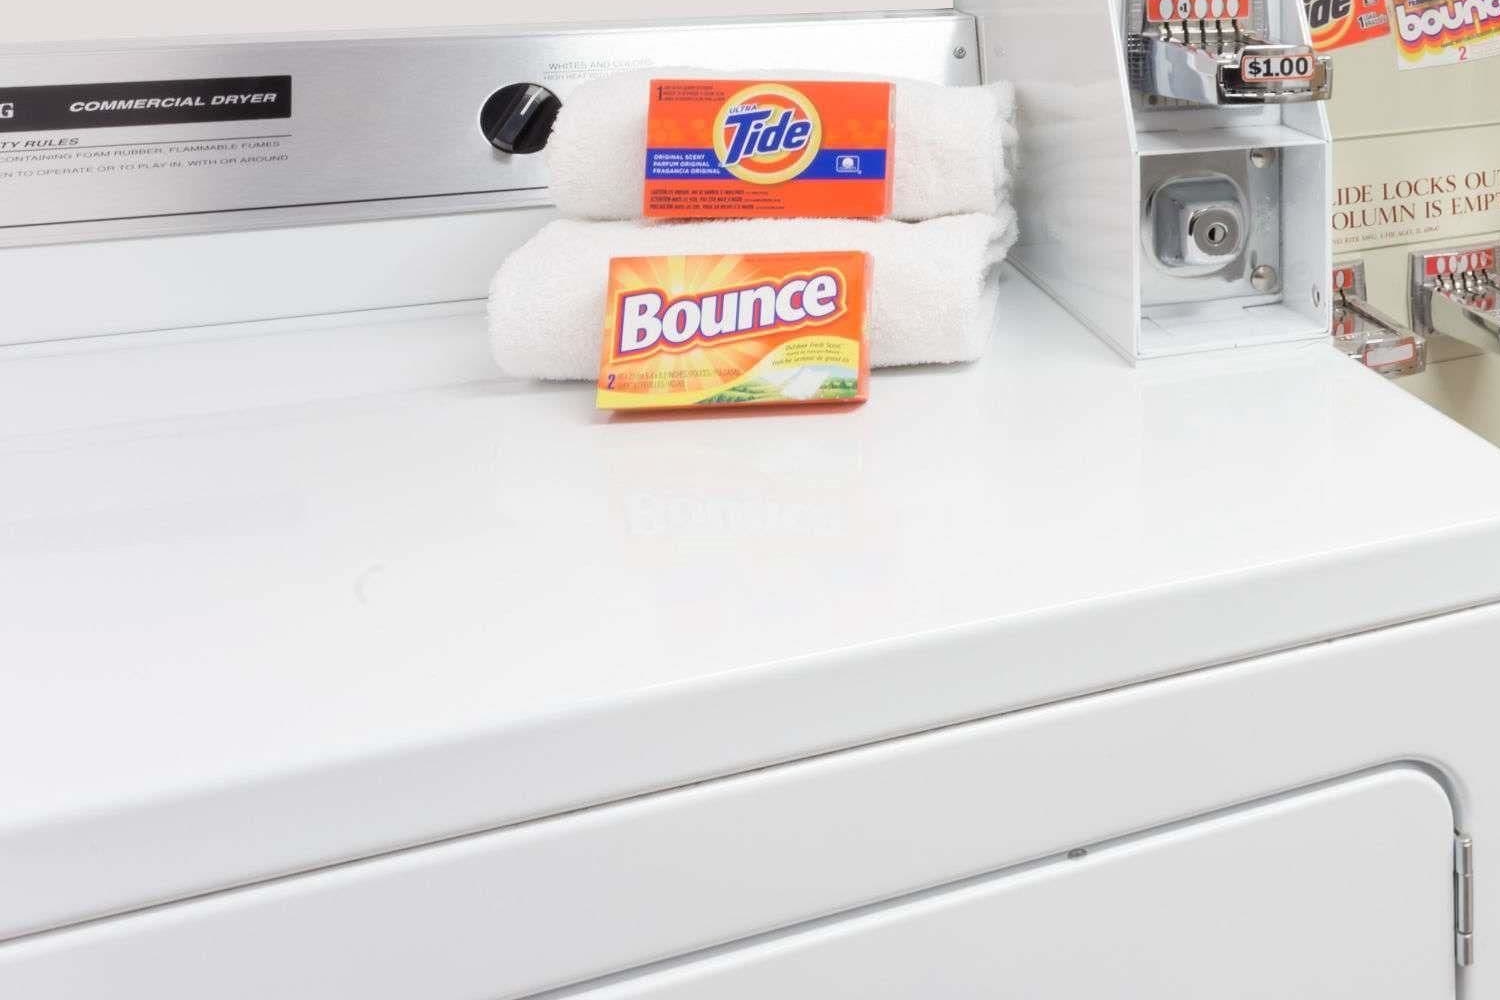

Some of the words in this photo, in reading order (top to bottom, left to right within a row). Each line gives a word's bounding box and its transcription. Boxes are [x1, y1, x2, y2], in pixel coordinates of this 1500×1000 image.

[1459, 46, 1467, 60] 2
[1248, 57, 1309, 78] $1.00
[70, 96, 205, 113] COMMERCIAL
[211, 93, 277, 106] DRYER
[729, 104, 758, 114] ULTRA
[24, 137, 80, 148] RULES
[724, 109, 812, 166] Tide
[240, 154, 288, 163] AROUND
[1333, 184, 1373, 206] IDE
[1383, 174, 1456, 201] LOCKS
[1332, 203, 1416, 231] OLUMN
[1425, 200, 1442, 218] IS
[620, 275, 838, 353] Bounce
[607, 374, 616, 390] 2
